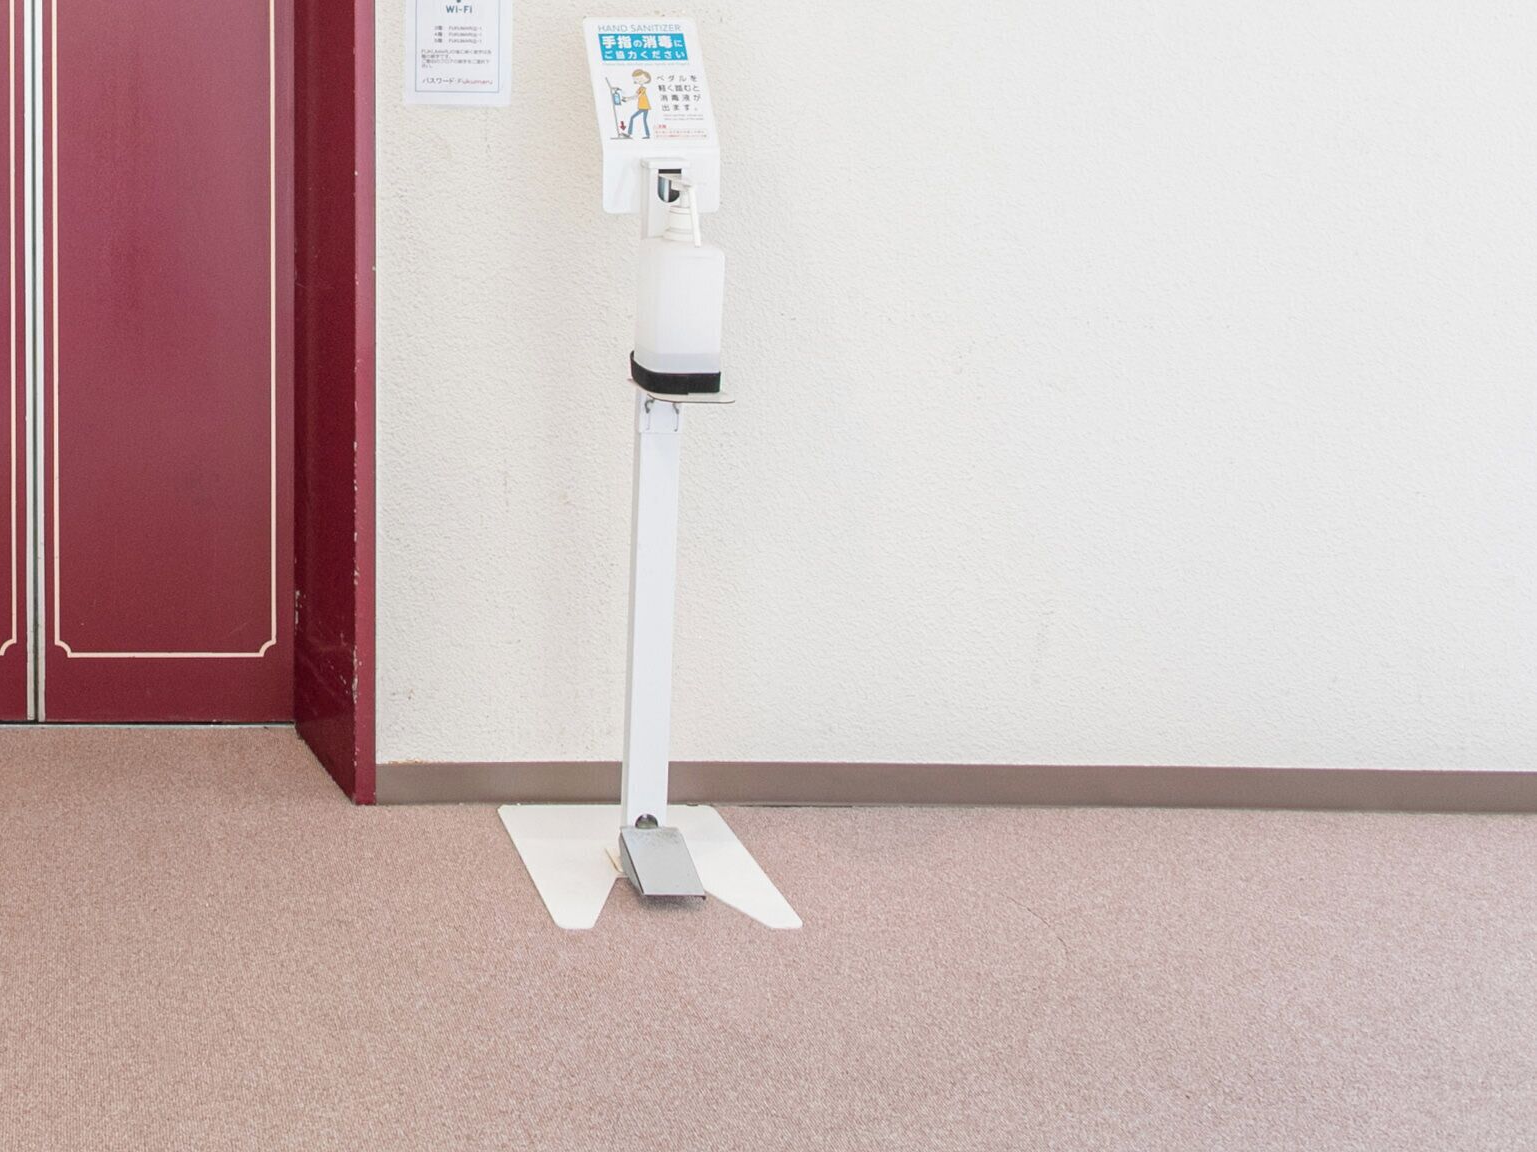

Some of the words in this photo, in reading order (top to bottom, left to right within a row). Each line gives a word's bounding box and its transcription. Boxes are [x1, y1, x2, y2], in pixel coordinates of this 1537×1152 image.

[597, 24, 628, 32] HAND
[601, 35, 683, 49] 手指の消毒に
[605, 50, 685, 59] ご協力ください
